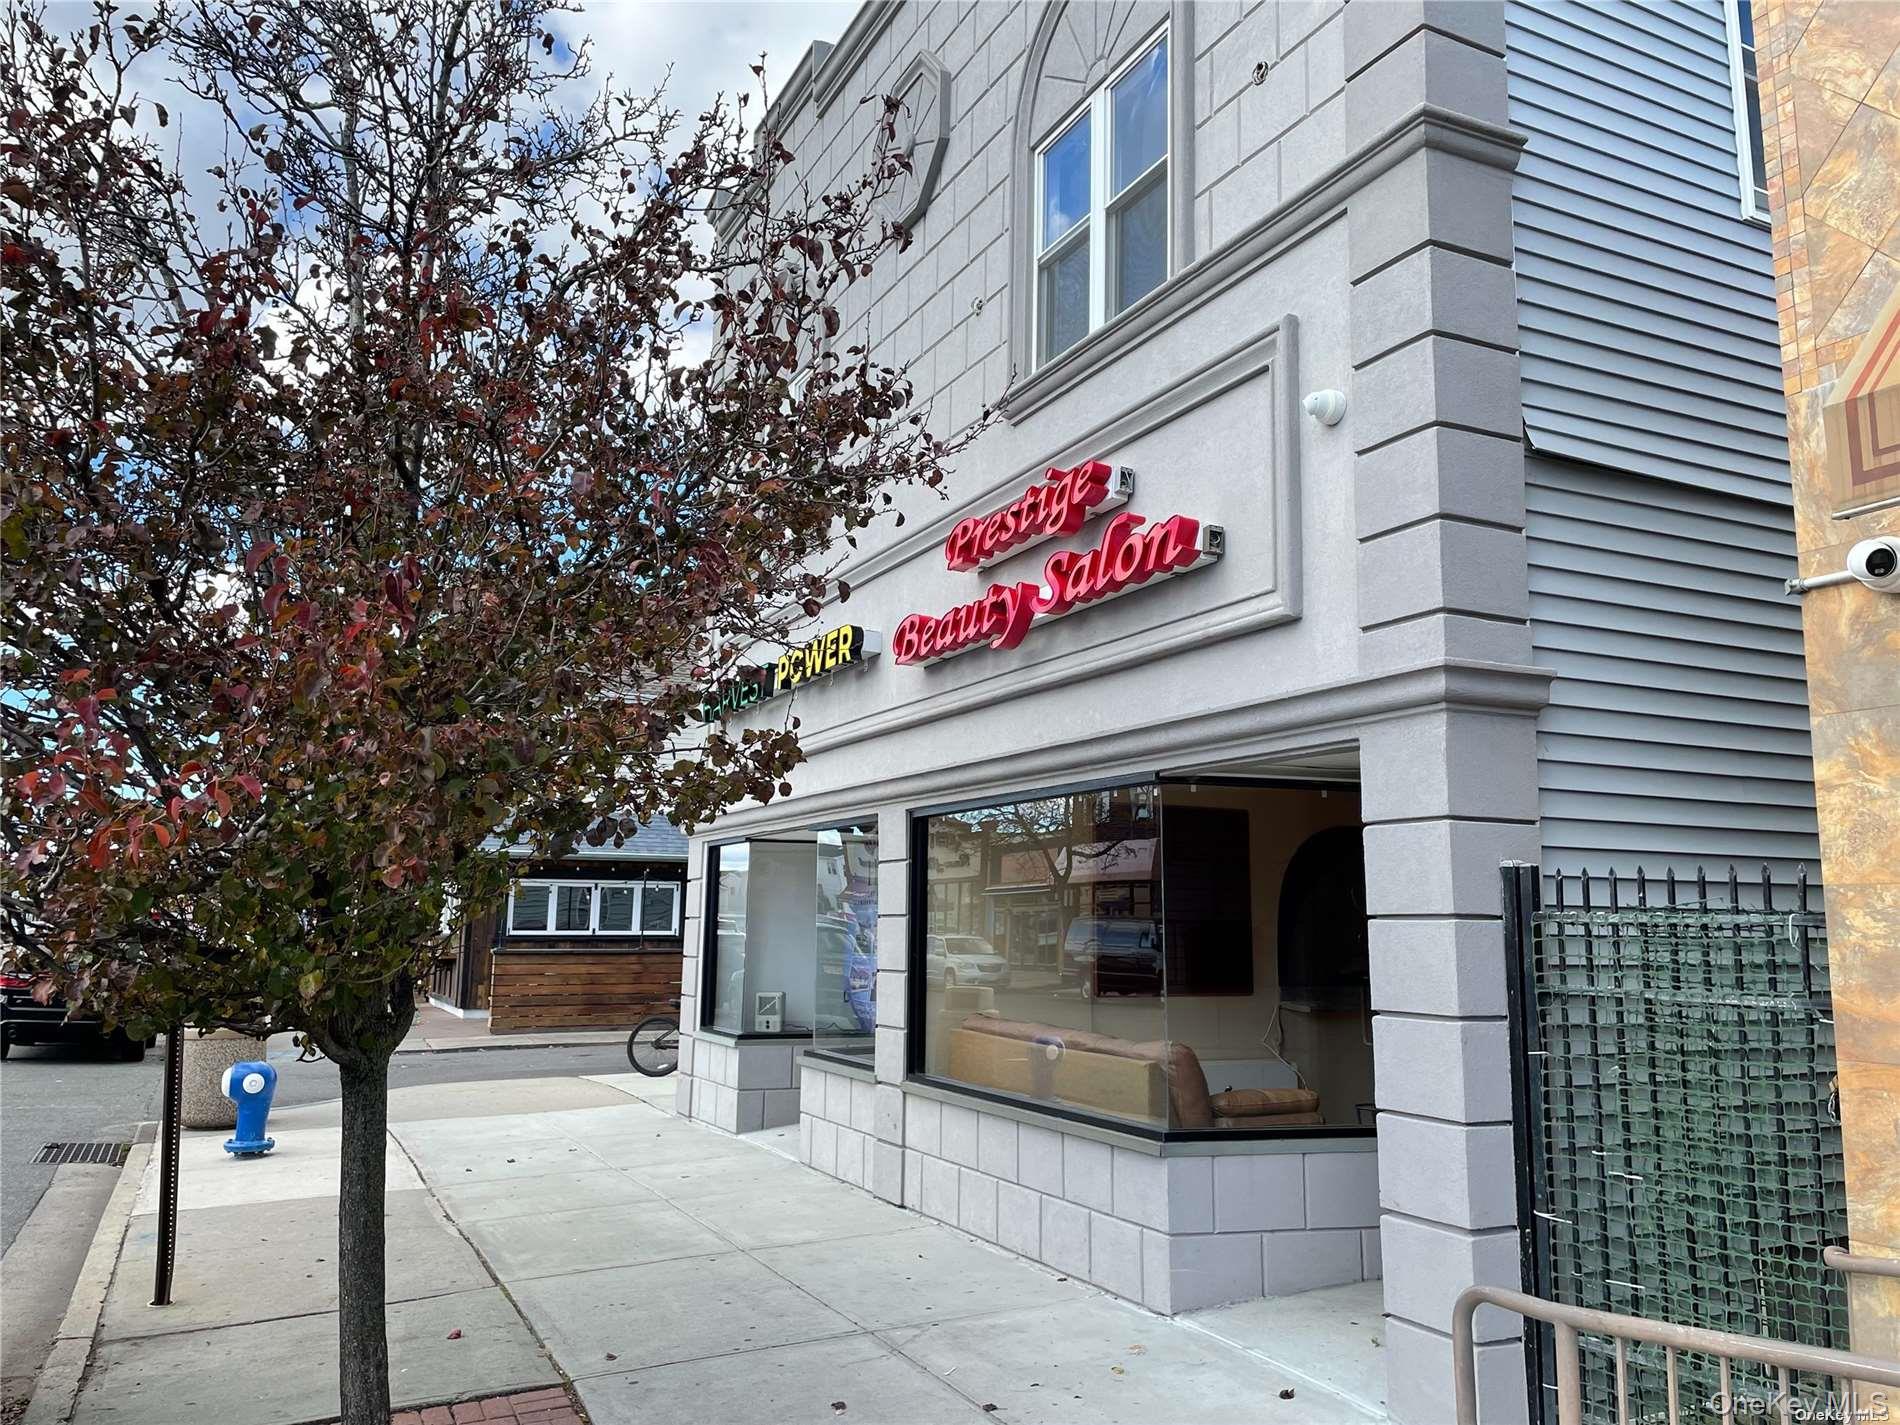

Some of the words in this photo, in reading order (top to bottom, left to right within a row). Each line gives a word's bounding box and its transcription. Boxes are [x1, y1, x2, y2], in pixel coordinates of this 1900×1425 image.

[945, 460, 1105, 571] Prestige
[893, 582, 1035, 664] Beauty
[1036, 513, 1192, 615] Salon
[777, 624, 854, 690] POWER
